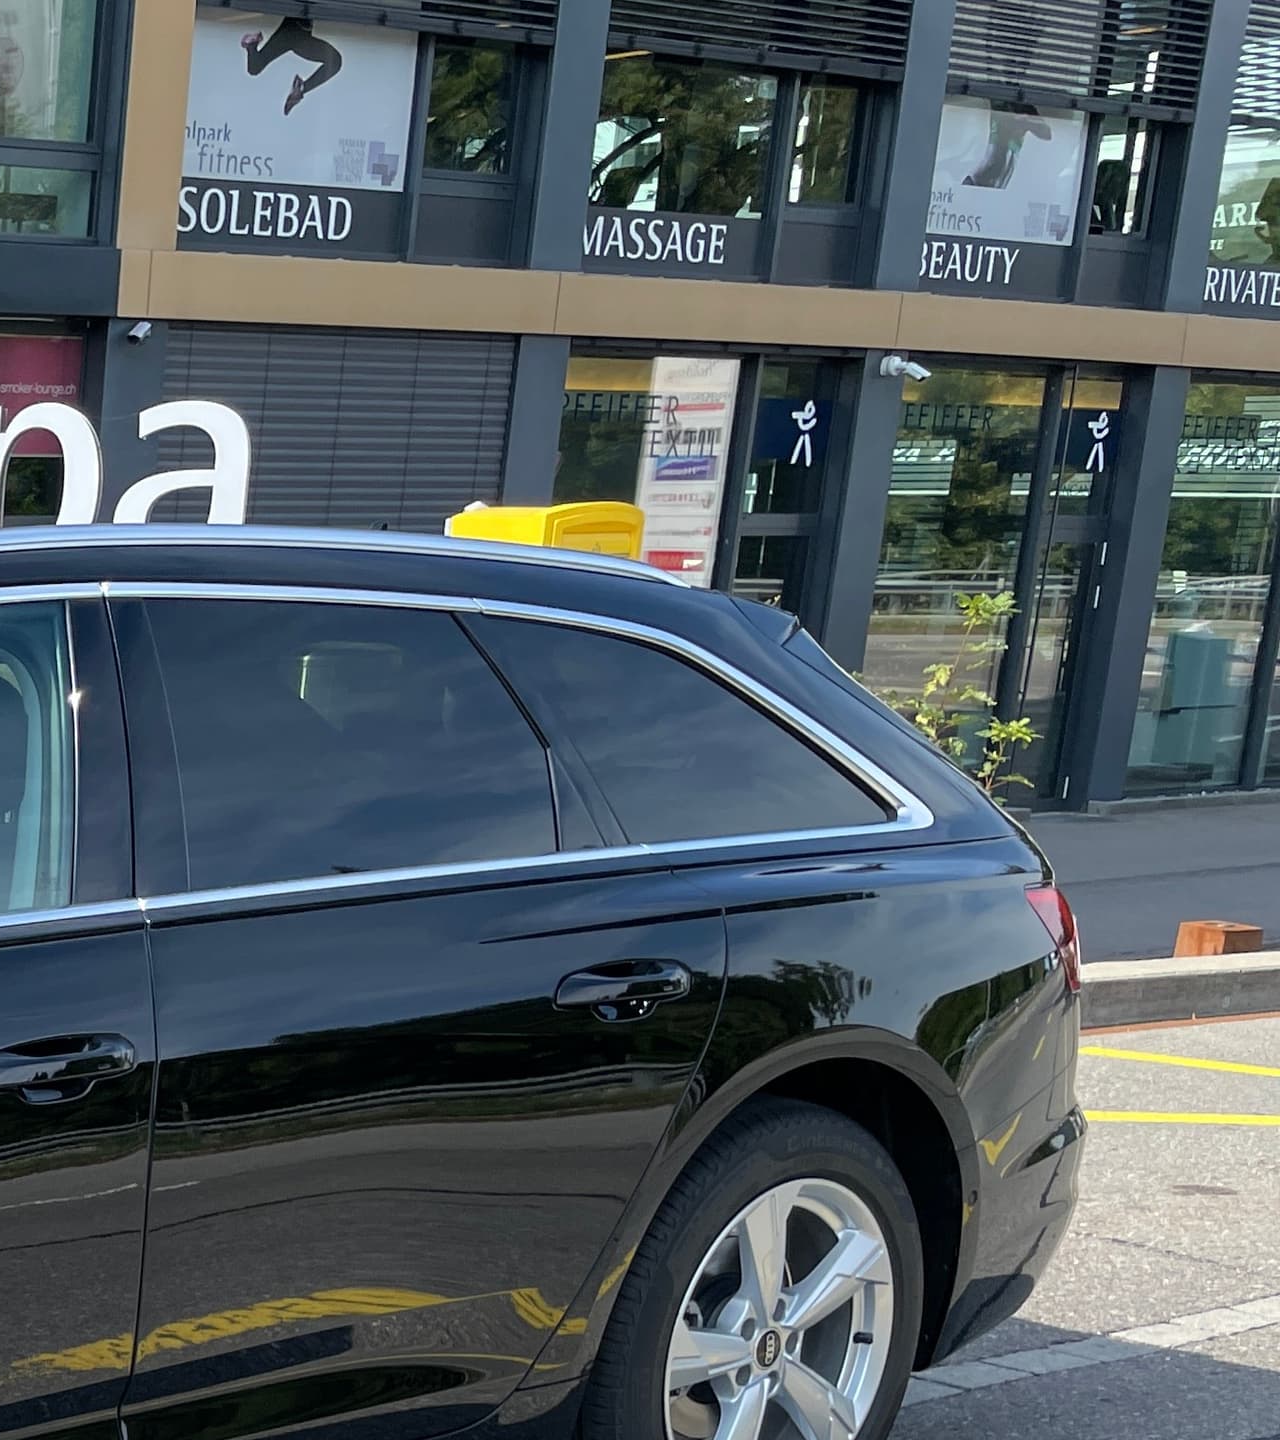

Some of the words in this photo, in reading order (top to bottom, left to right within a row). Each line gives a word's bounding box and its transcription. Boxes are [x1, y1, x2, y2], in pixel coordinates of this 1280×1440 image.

[197, 143, 274, 177] fitness
[176, 185, 353, 241] SOLEBAD
[928, 204, 983, 233] fitness
[582, 215, 728, 265] MASSAGE
